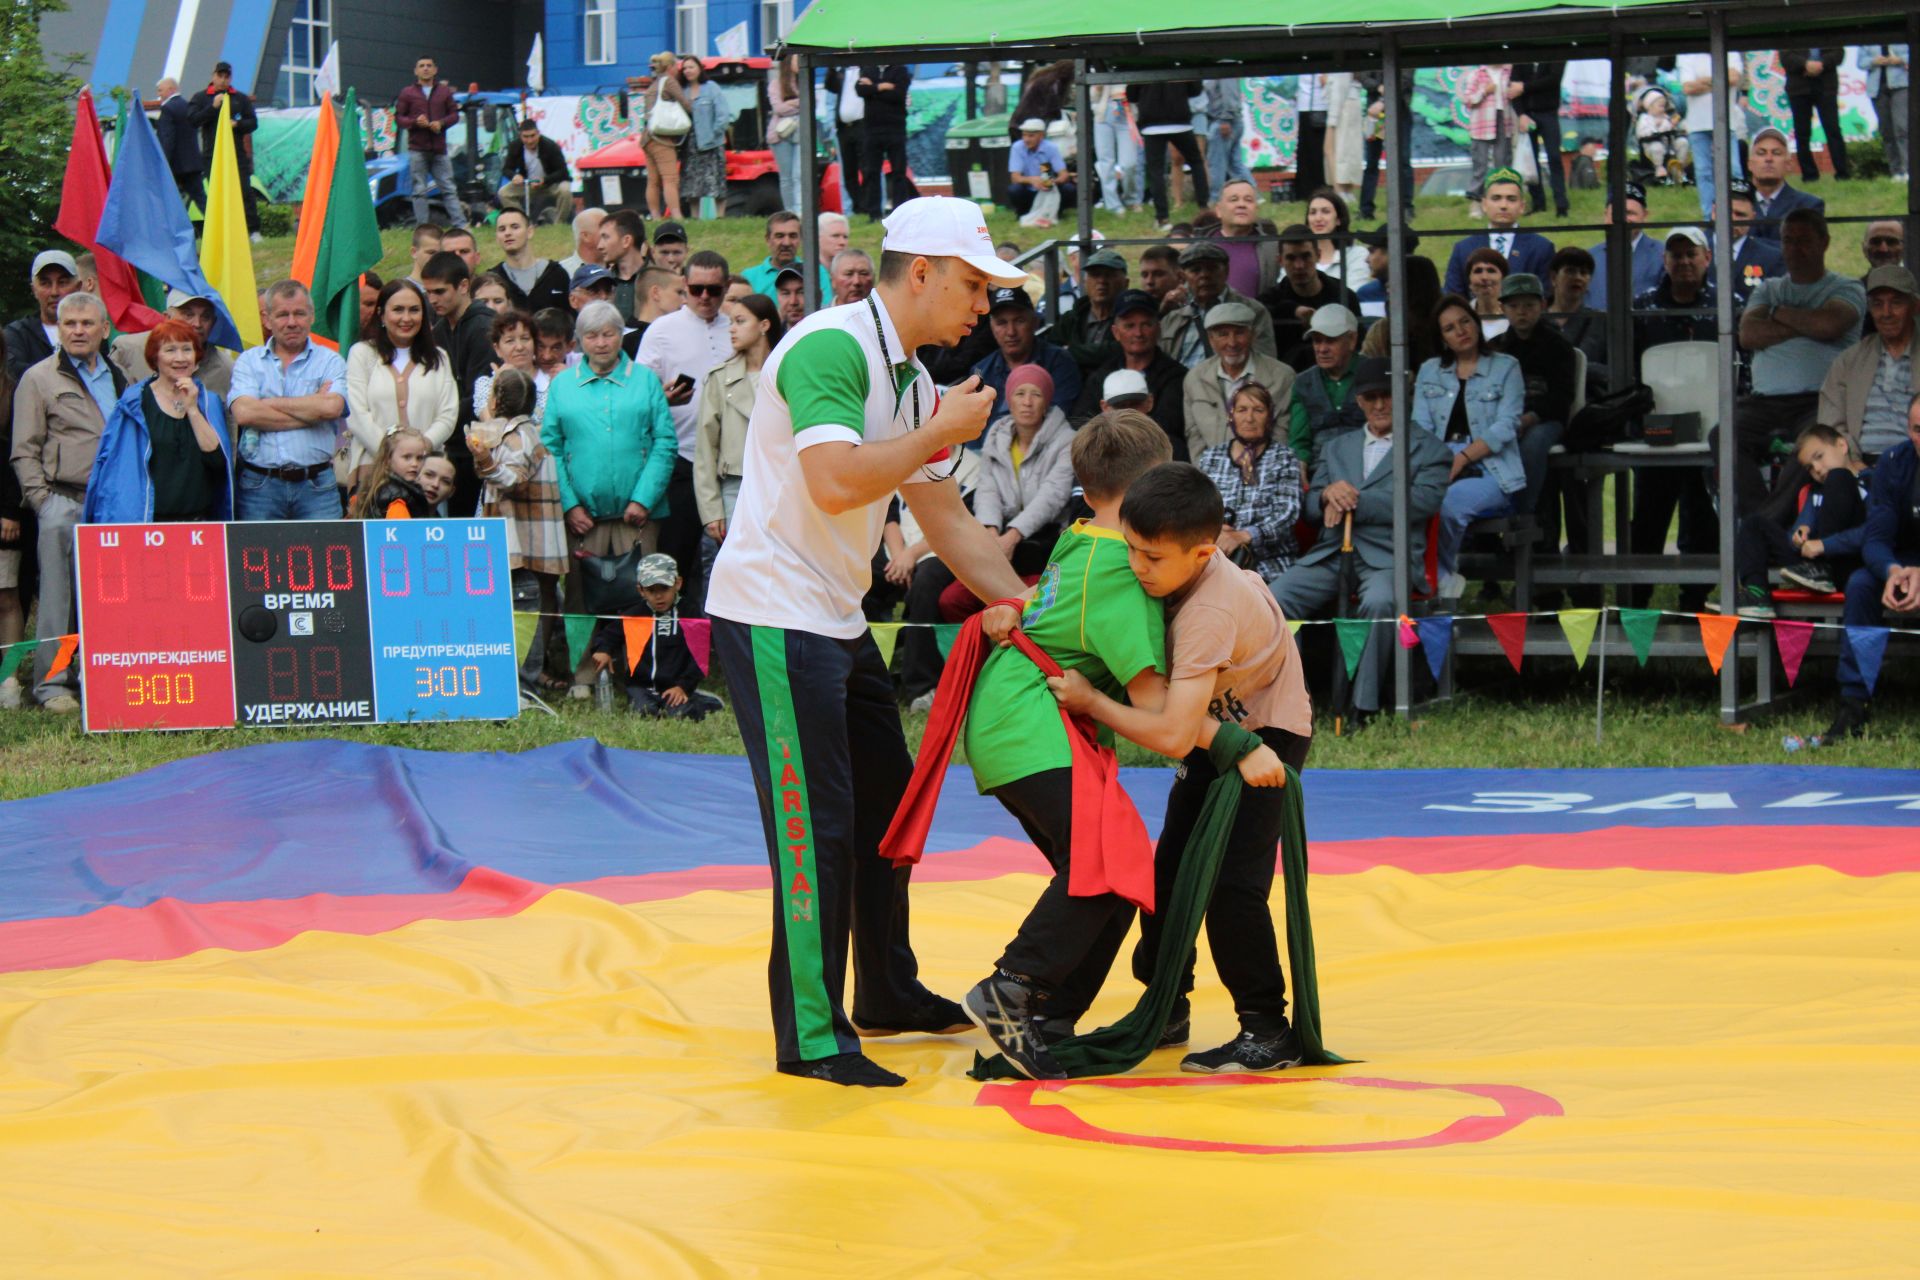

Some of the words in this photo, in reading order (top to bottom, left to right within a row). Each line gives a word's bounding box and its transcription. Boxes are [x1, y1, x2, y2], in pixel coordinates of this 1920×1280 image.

[100, 531, 119, 547] Ш
[144, 530, 164, 547] Ю
[191, 530, 204, 546] К
[386, 527, 398, 542] К
[425, 526, 445, 542] Ю
[467, 526, 486, 541] Ш
[243, 544, 353, 591] 4:00
[264, 592, 335, 609] ВРЕМЯ
[92, 650, 227, 668] ПРЕДУПРЕЖДЕНИЕ
[383, 643, 512, 660] ПРЕДУПРЕЖДЕНИЕ
[127, 673, 195, 706] 3:00
[416, 665, 481, 698] 3:00
[244, 700, 371, 723] УДЕРЖАНИЕ
